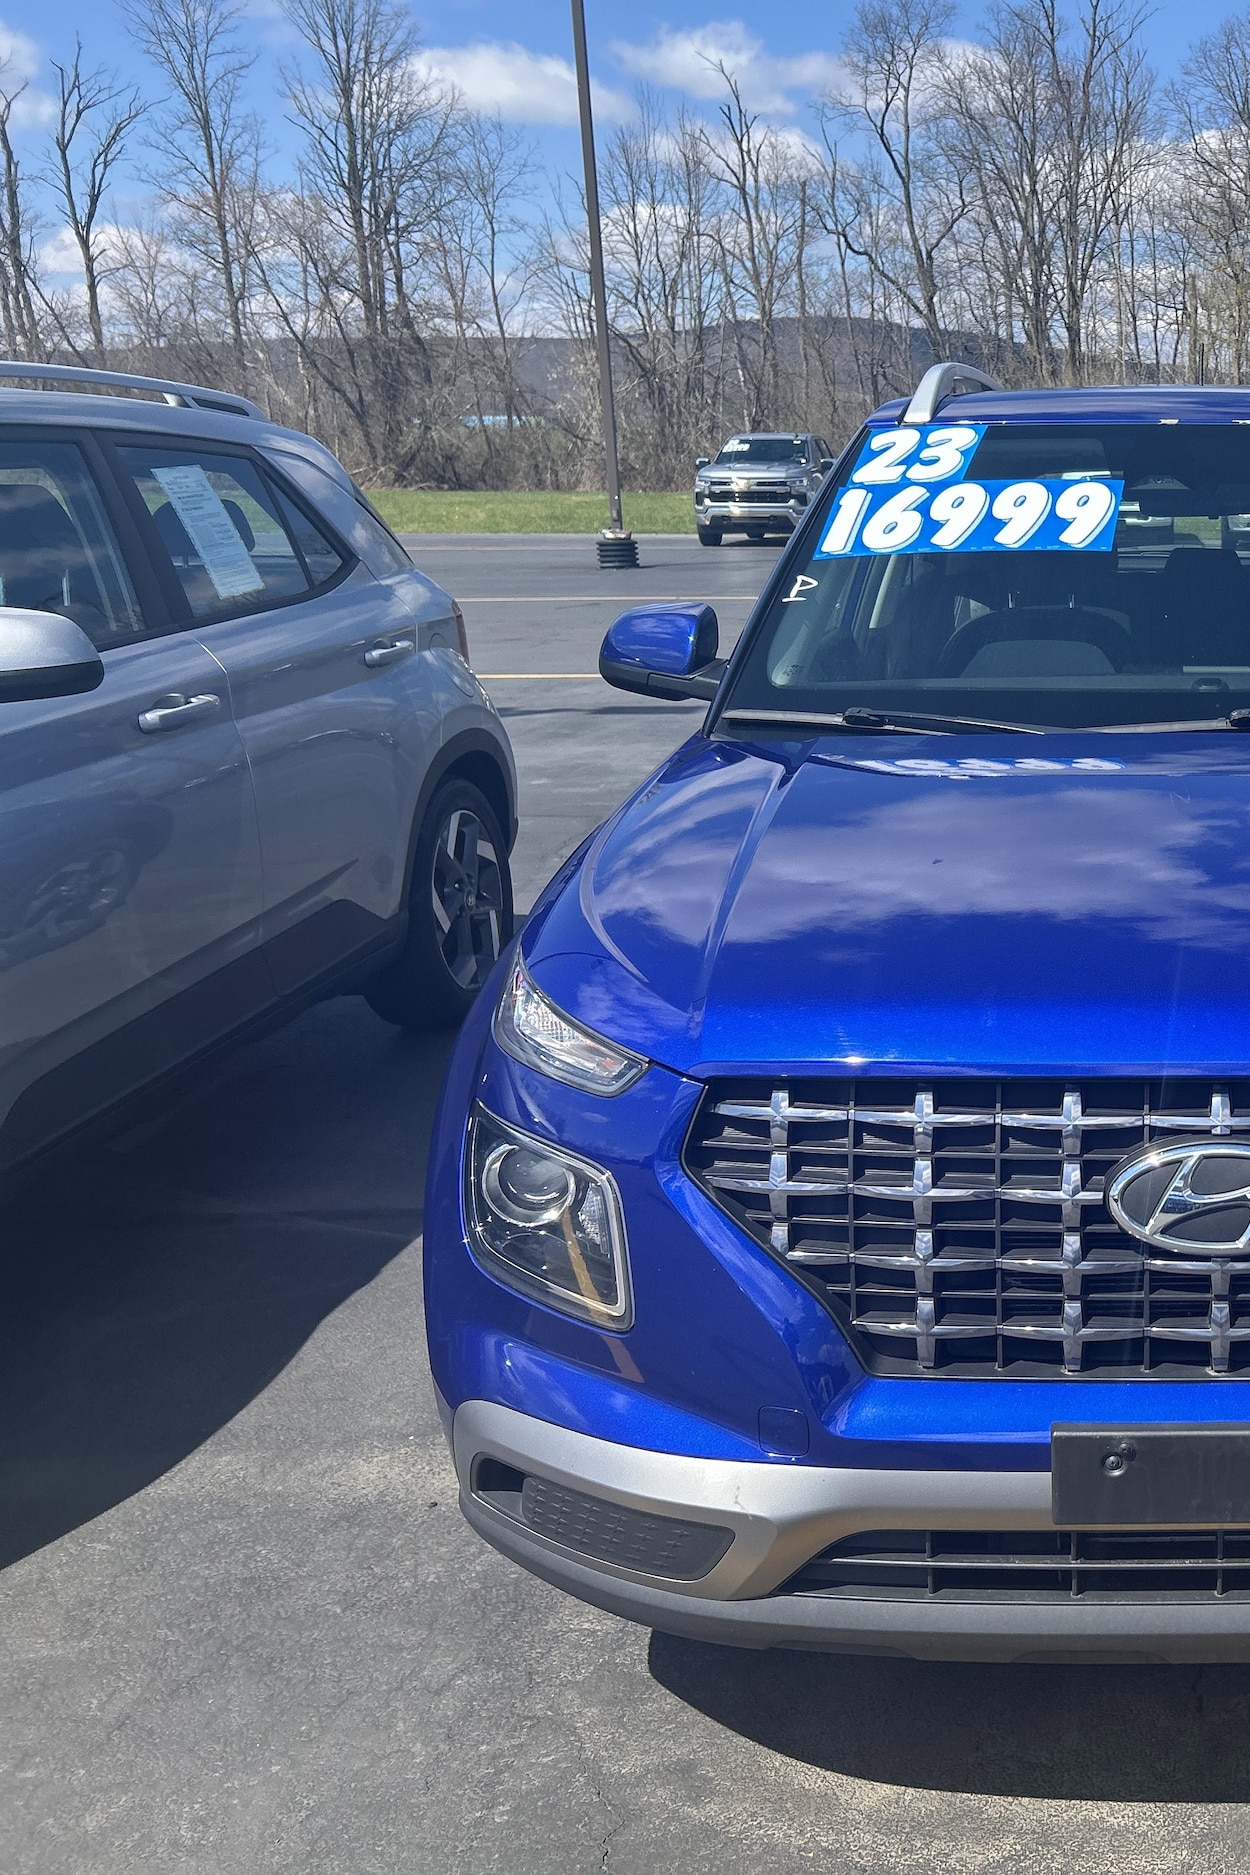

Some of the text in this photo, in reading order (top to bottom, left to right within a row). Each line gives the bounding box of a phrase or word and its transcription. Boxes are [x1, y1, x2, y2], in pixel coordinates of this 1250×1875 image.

[851, 426, 979, 485] 23
[820, 481, 1116, 554] 16999
[781, 574, 819, 602] P
